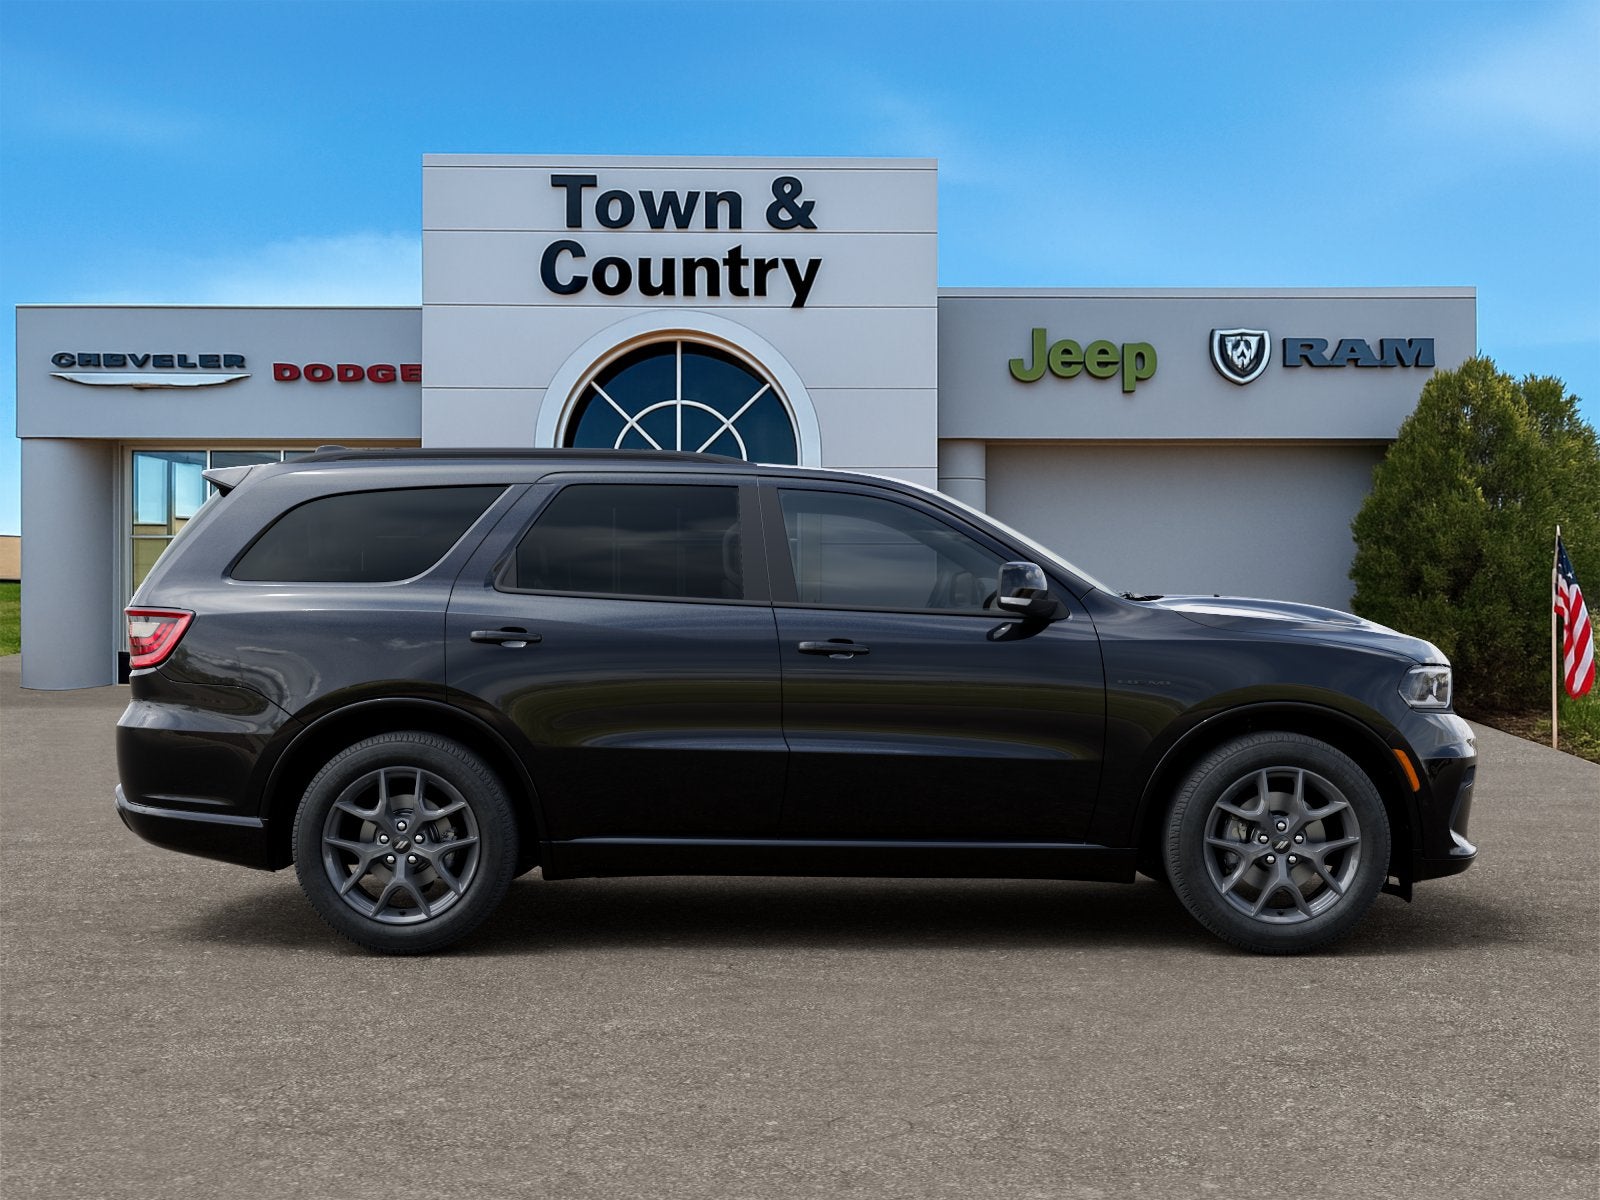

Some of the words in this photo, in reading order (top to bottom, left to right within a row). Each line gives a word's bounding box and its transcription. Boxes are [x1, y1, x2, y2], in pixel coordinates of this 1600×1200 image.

[550, 174, 743, 229] Town
[765, 176, 818, 230] &
[540, 239, 822, 308] Country
[272, 363, 421, 383] DODGE
[1008, 328, 1158, 393] Jeep
[1283, 337, 1435, 368] RAM
